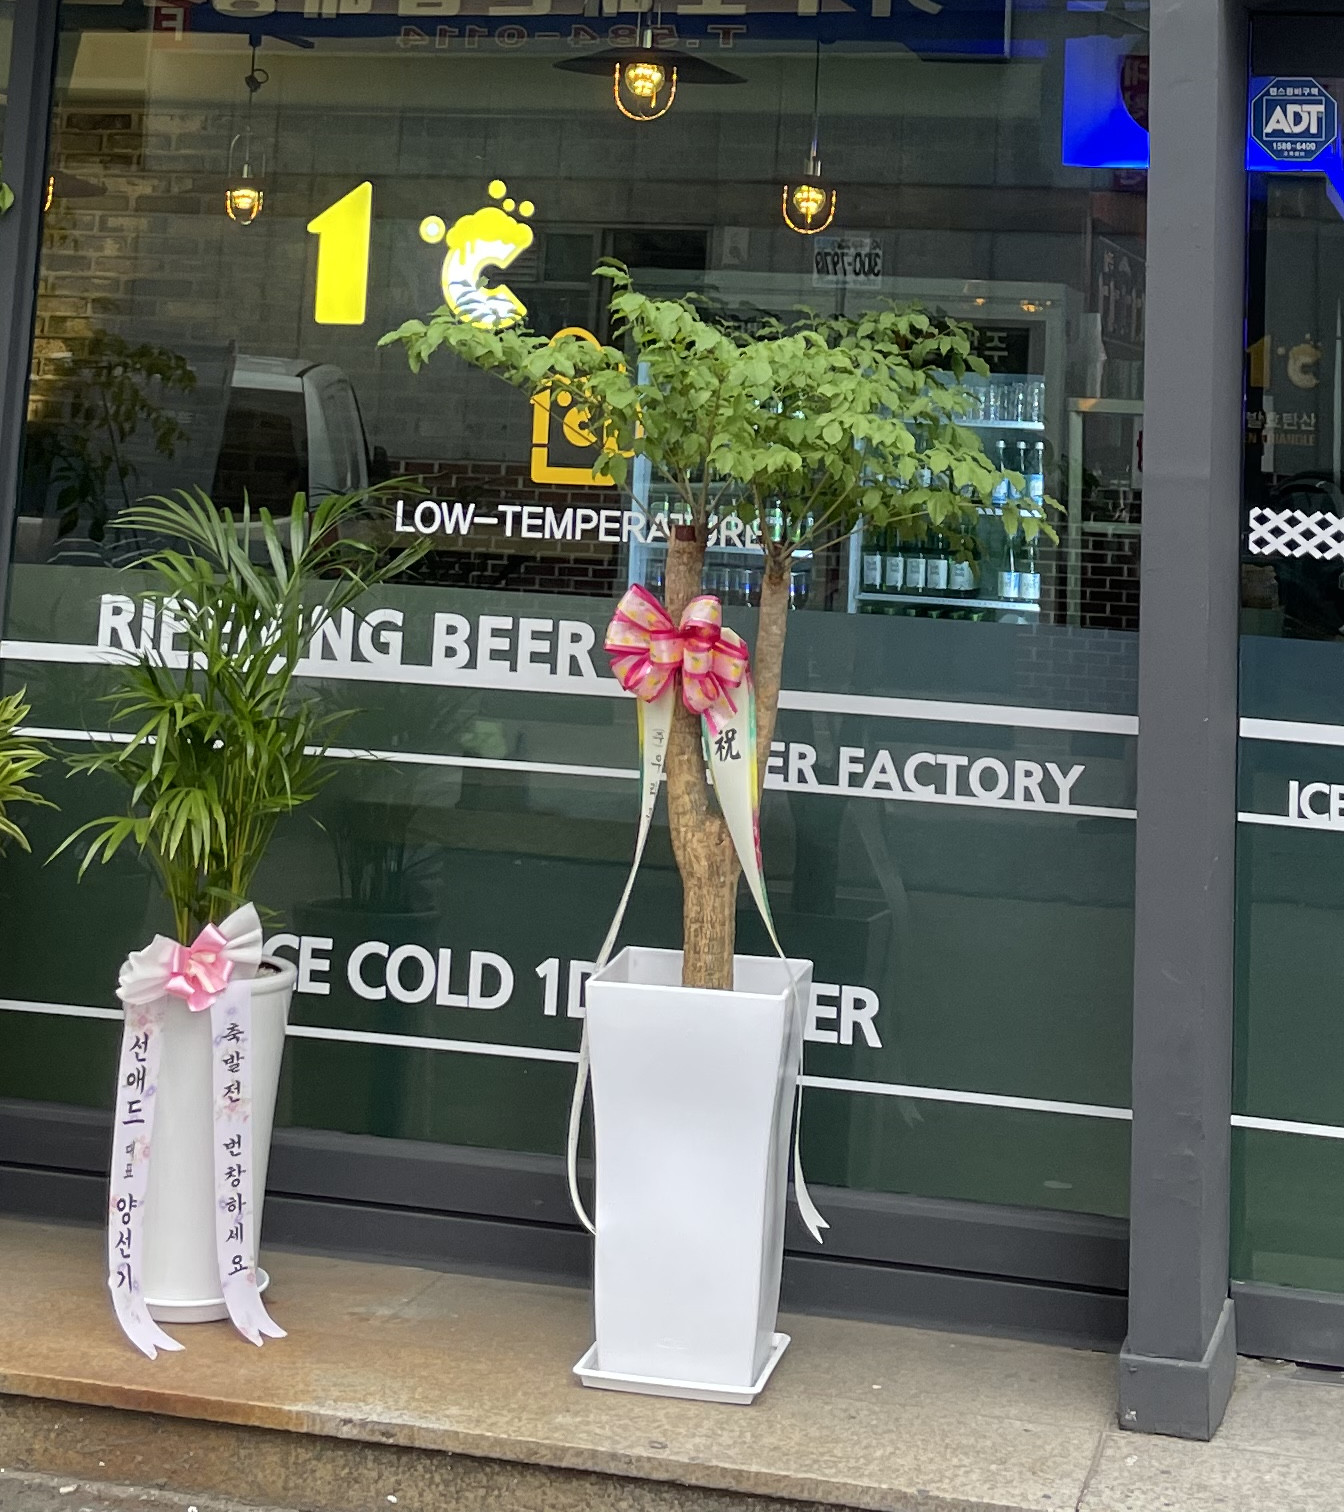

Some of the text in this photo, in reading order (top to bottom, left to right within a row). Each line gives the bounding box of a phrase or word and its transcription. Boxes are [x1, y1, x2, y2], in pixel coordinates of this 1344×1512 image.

[1264, 103, 1325, 135] ADT
[431, 612, 598, 679] BEER
[714, 728, 741, 762] 祝
[839, 746, 1085, 807] FACTORY
[348, 941, 515, 1011] COLD
[805, 982, 883, 1049] ER
[122, 1033, 150, 1125] 선애드
[115, 1192, 140, 1291] 양선기
[223, 1134, 249, 1277] 번창하세요
